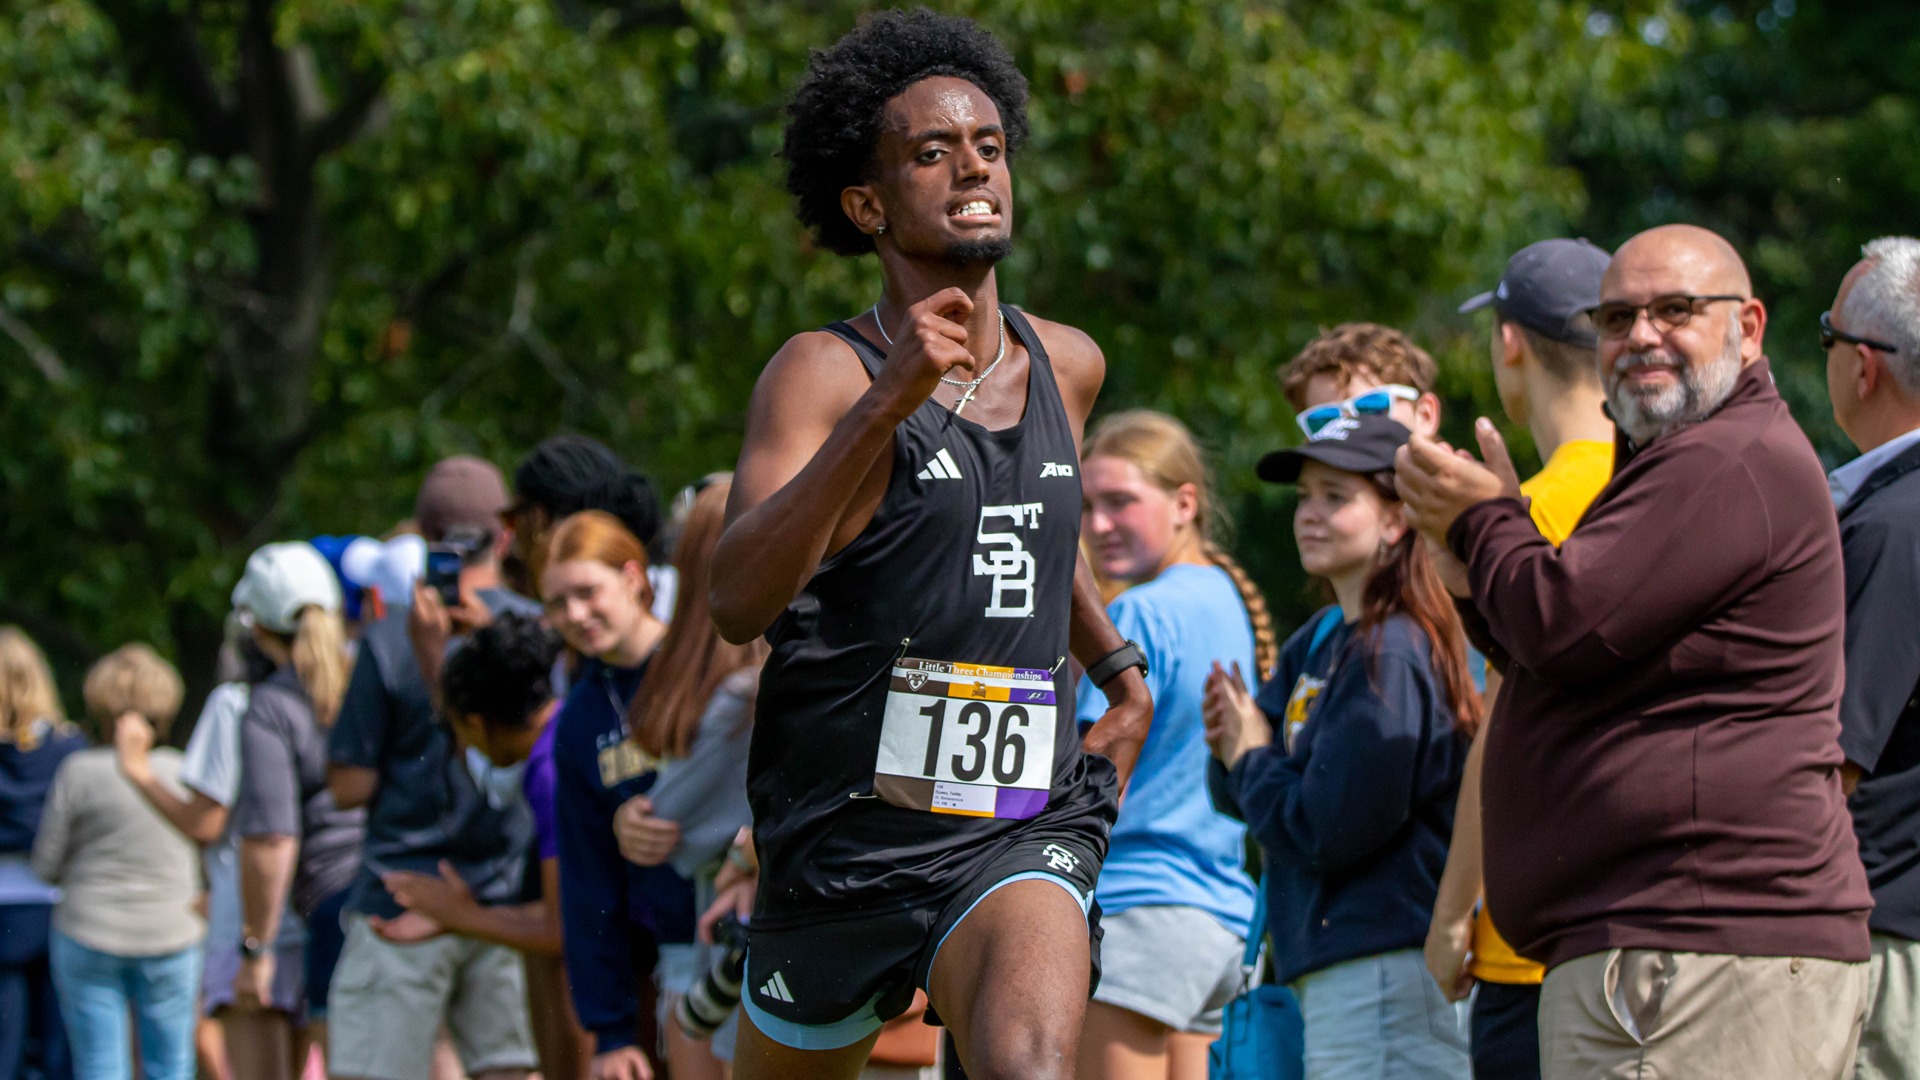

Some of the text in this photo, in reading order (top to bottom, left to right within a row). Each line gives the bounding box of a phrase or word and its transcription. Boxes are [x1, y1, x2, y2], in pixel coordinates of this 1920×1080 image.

[918, 661, 1042, 681] Little Three Championships
[919, 698, 1030, 785] 136
